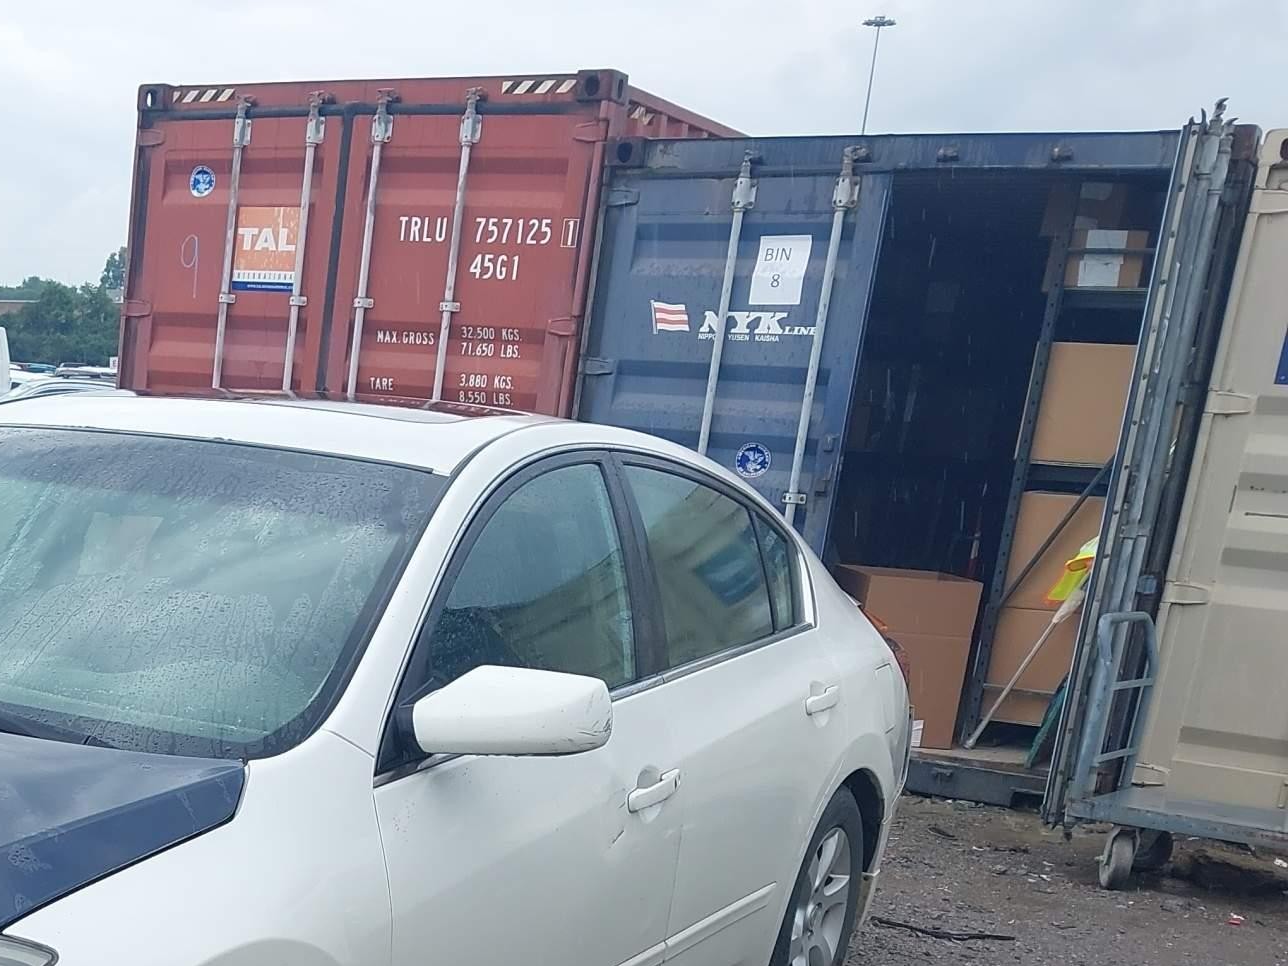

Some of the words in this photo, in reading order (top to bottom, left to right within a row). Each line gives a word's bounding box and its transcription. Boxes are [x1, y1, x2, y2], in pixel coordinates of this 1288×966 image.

[399, 216, 448, 242] TRLU
[475, 217, 552, 245] 757125
[237, 227, 296, 252] TAL
[764, 247, 792, 262] BIN
[469, 253, 520, 281] 45G1
[770, 273, 781, 288] 8
[376, 330, 435, 346] MAX.GROSS
[501, 328, 523, 342] KGS.
[460, 342, 495, 357] 71.650
[500, 344, 521, 358] LBS.
[370, 377, 394, 391] TARE
[493, 375, 515, 390] KGS.
[493, 392, 515, 406] LBS.
